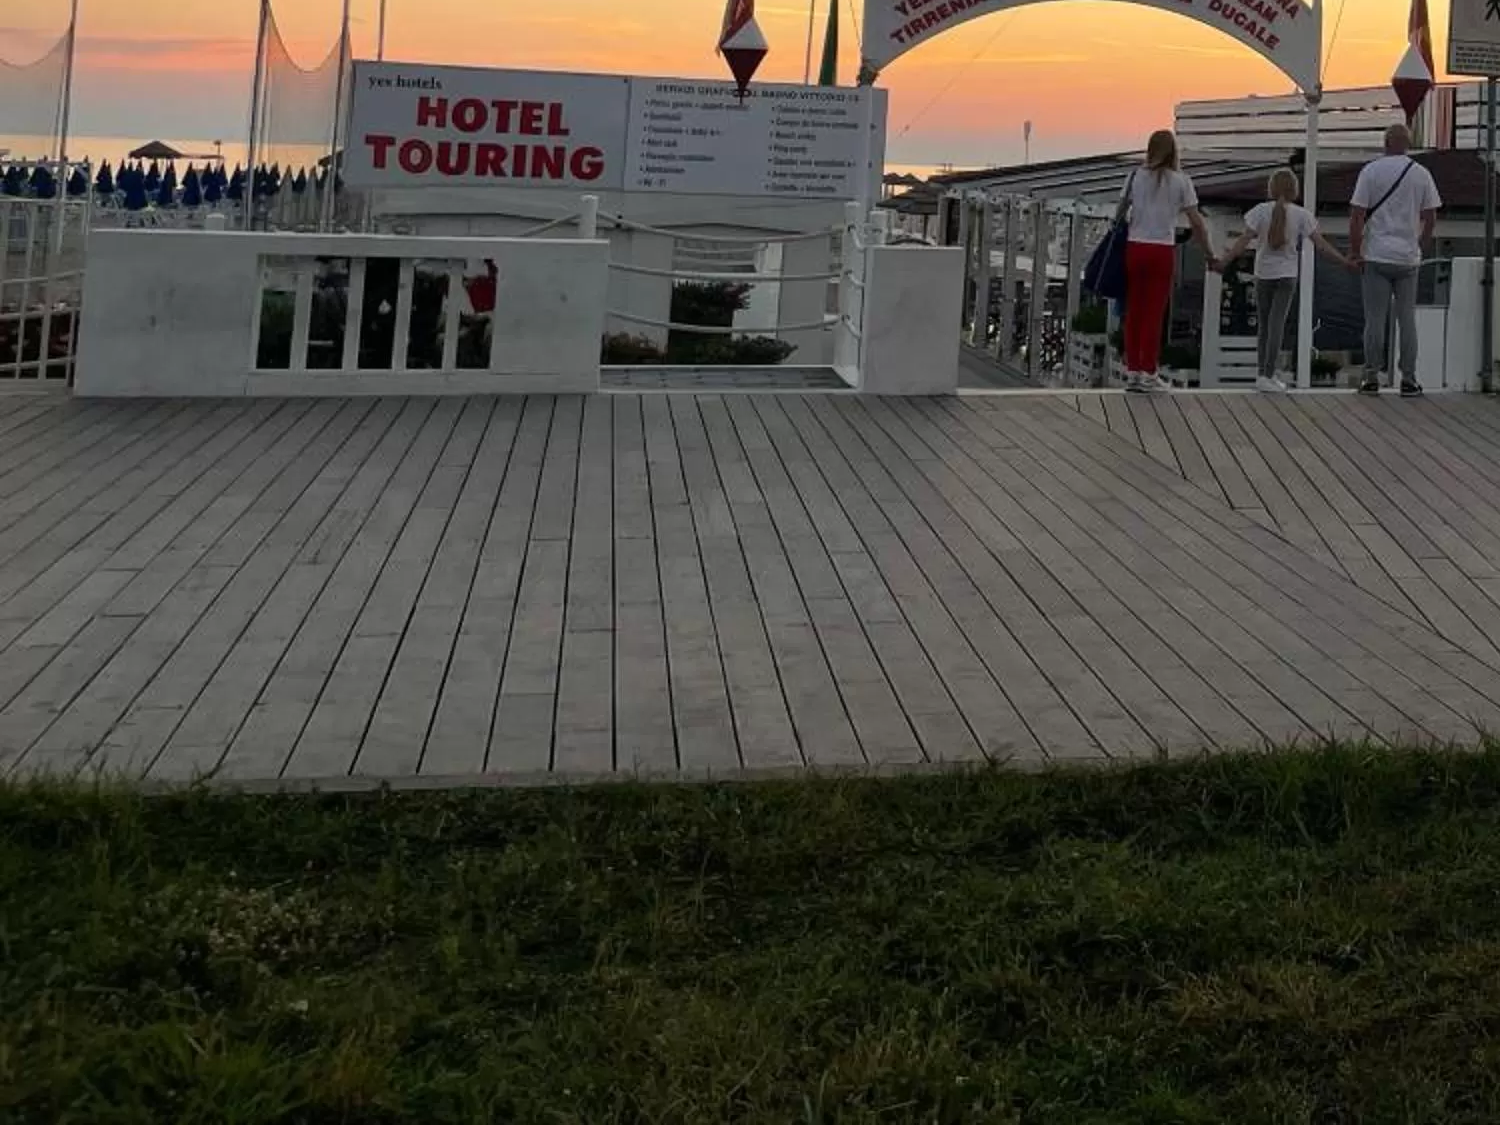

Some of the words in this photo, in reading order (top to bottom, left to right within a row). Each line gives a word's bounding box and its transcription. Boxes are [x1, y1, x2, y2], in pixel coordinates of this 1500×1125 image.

[368, 76, 393, 89] yes
[396, 75, 442, 90] hotels
[416, 96, 570, 137] HOTEL
[364, 134, 605, 181] TOURING
